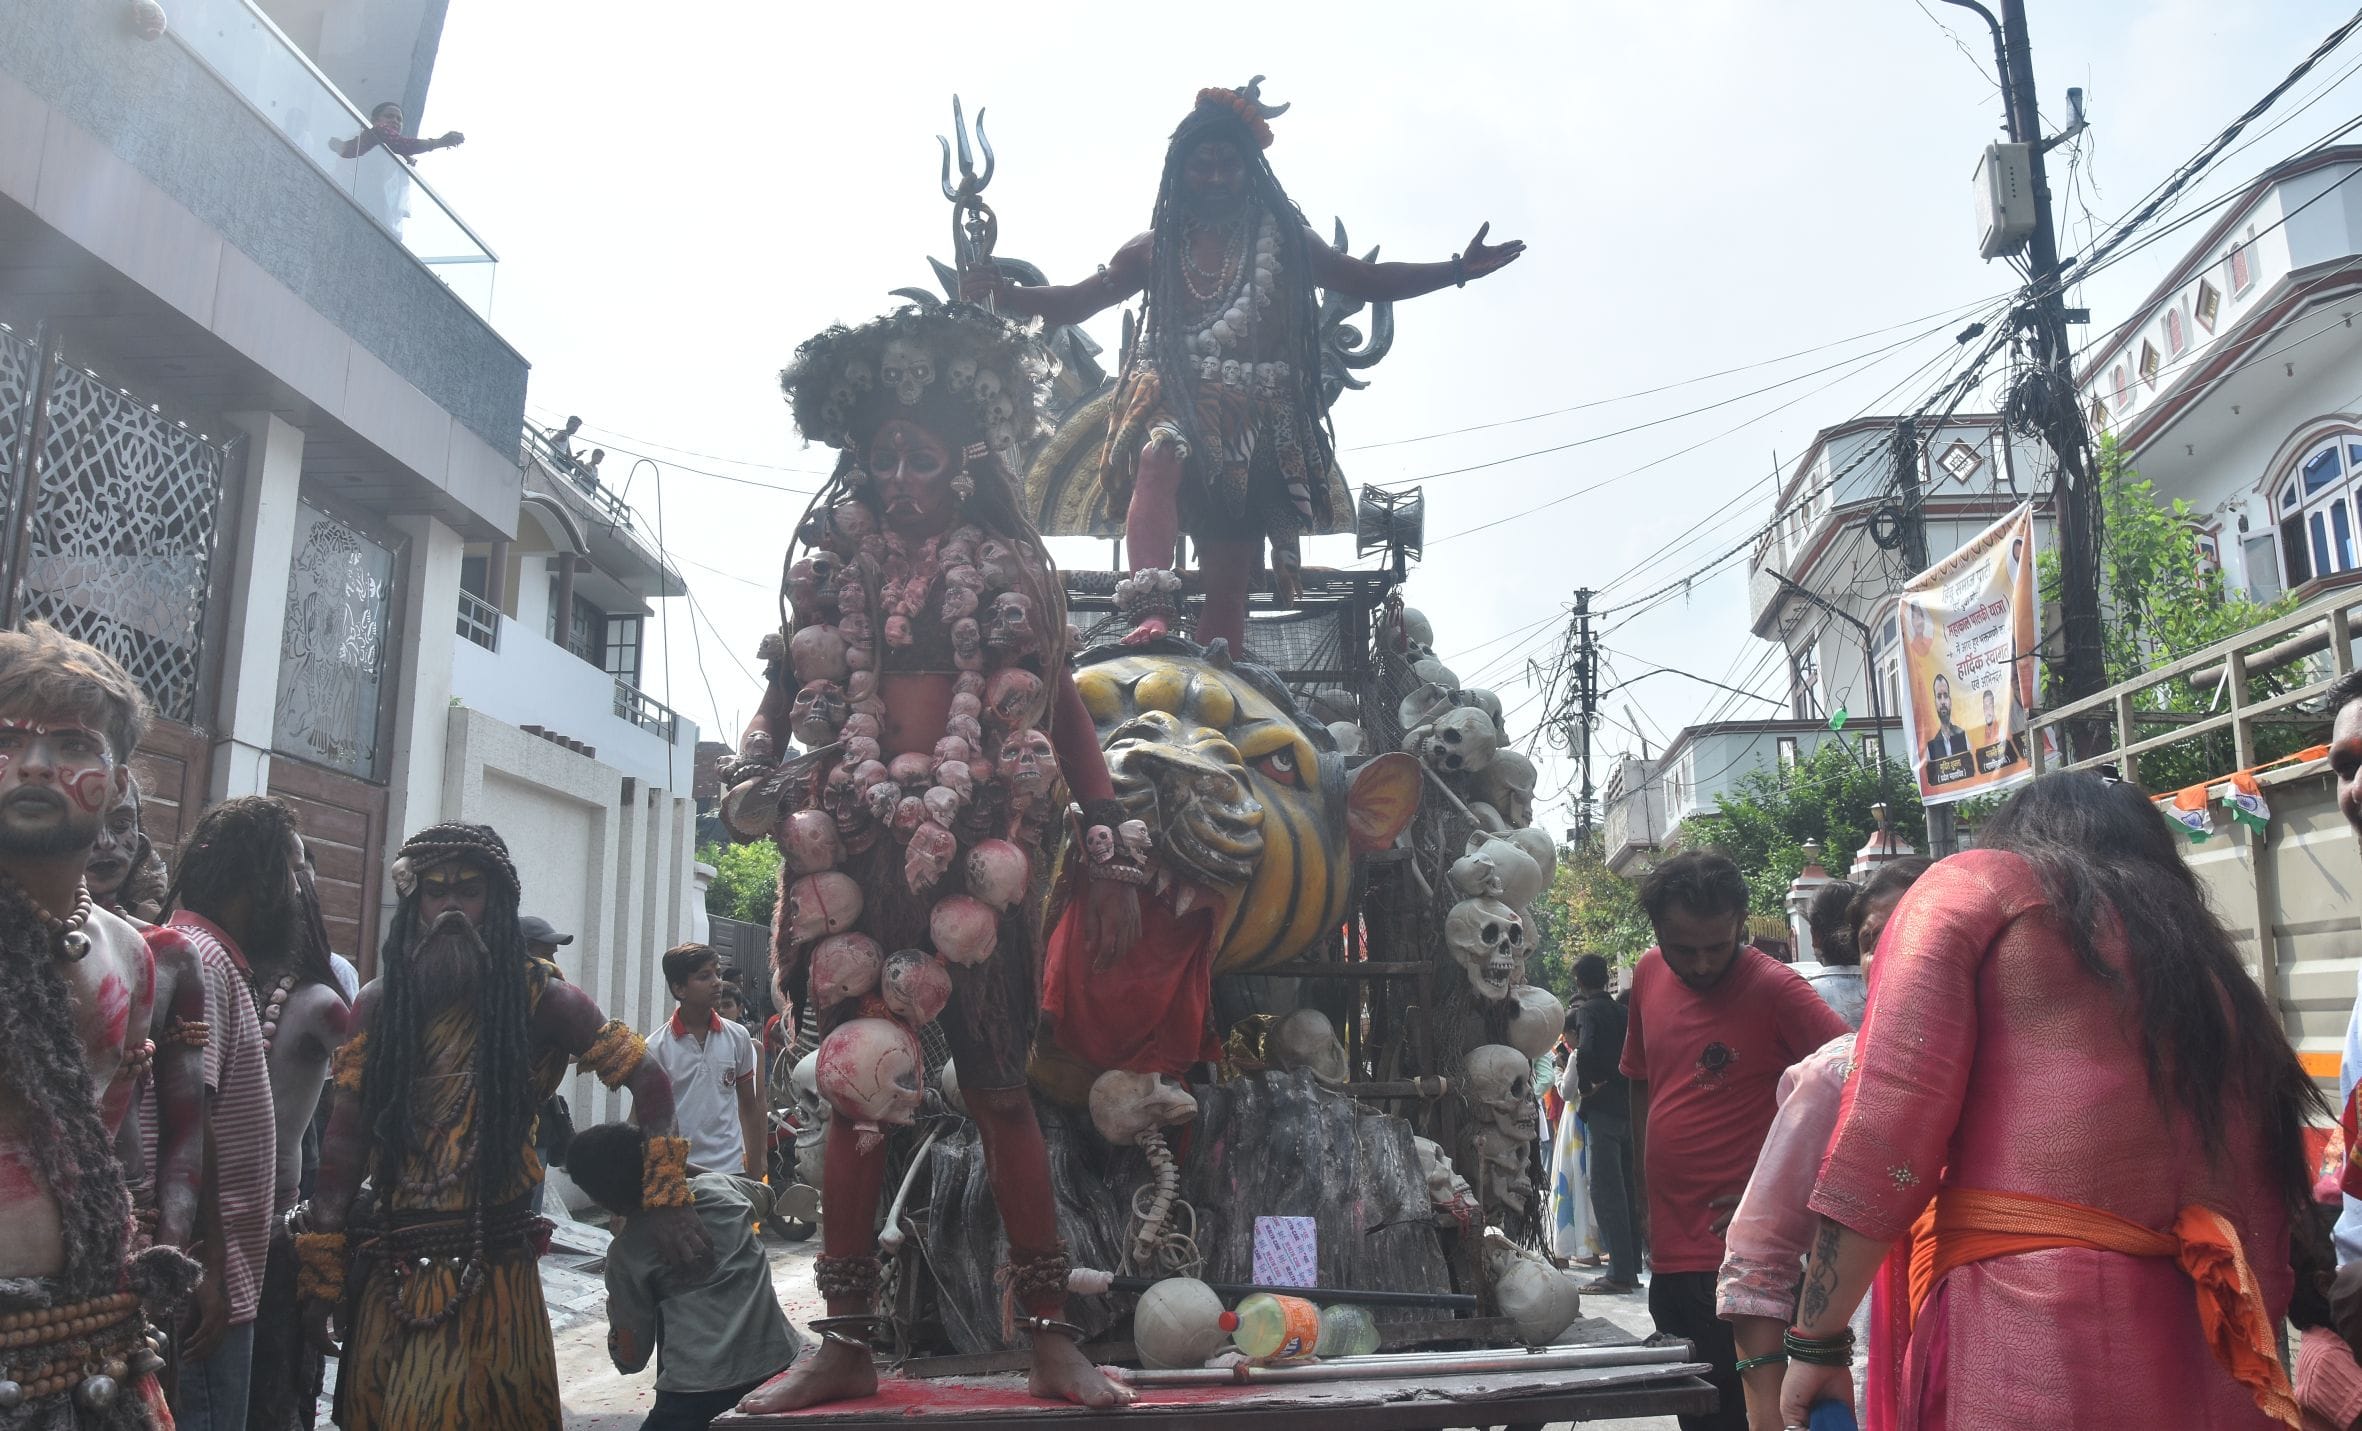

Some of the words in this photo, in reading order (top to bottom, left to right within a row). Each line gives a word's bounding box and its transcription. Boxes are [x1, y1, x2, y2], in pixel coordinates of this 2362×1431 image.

[1946, 616, 1972, 638] महाकाल
[1987, 599, 2007, 617] यात्रा
[1956, 652, 1984, 680] हार्दिक
[1984, 643, 2010, 667] स्वागत
